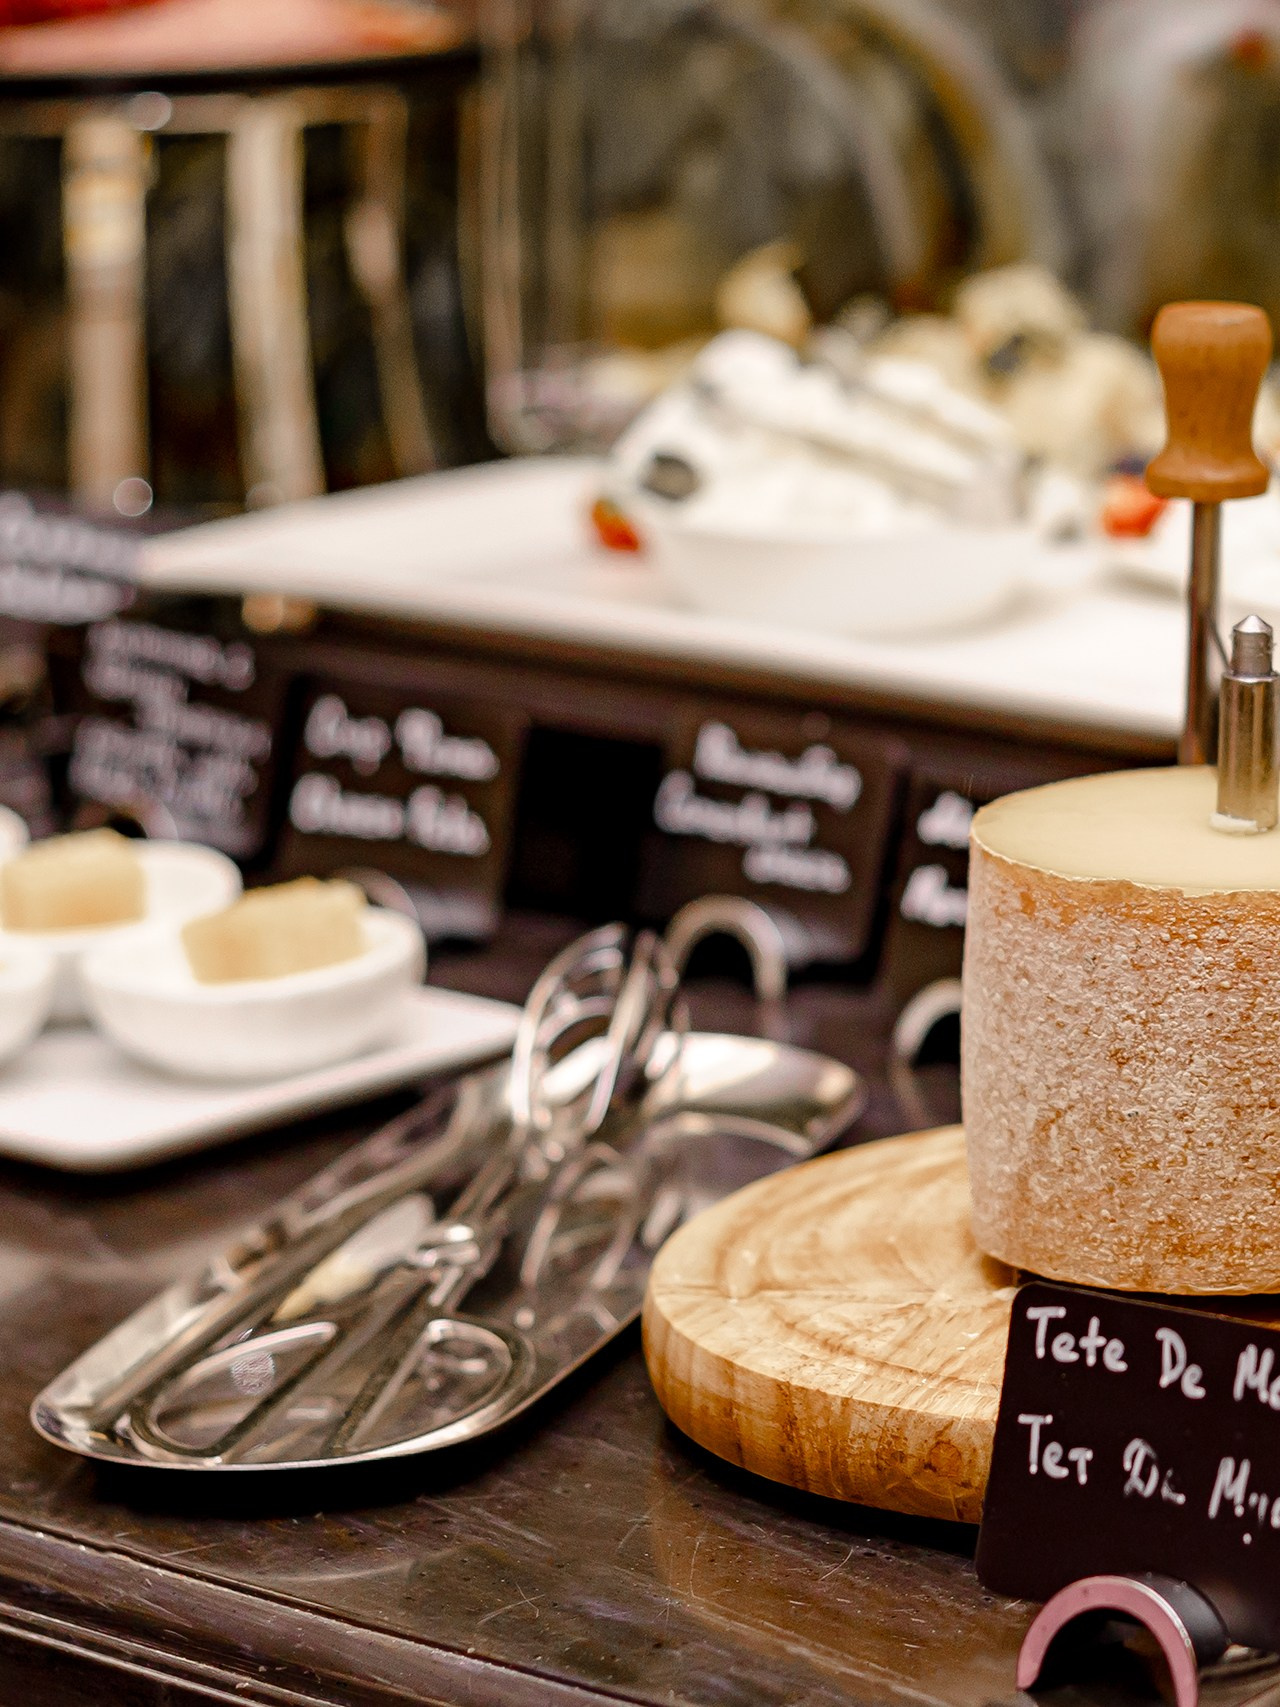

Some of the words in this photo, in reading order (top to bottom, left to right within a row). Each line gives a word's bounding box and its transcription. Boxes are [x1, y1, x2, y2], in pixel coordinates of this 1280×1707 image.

[1026, 1306, 1128, 1372] Tete
[1155, 1327, 1206, 1399] De
[1017, 1413, 1094, 1485] Тет
